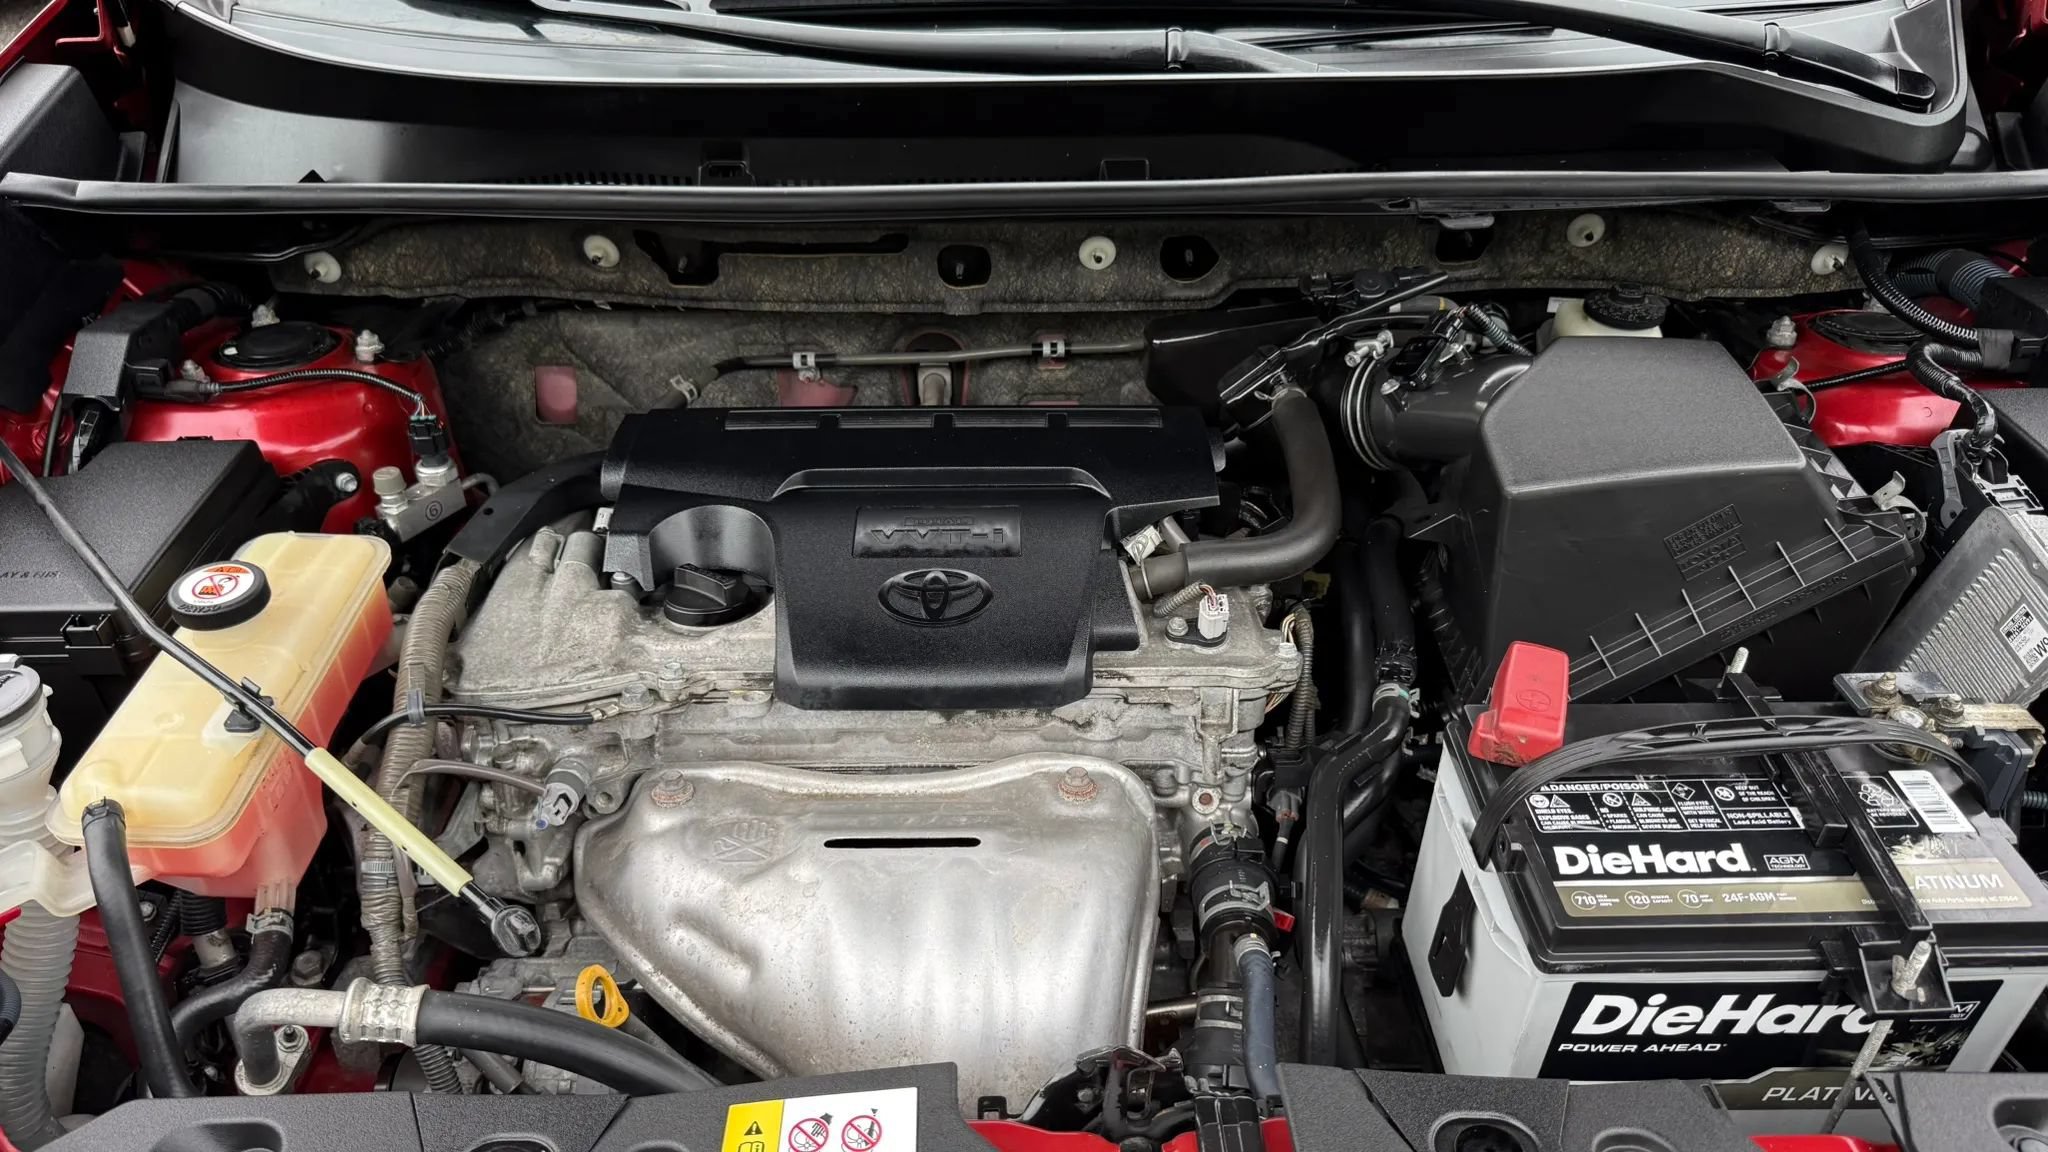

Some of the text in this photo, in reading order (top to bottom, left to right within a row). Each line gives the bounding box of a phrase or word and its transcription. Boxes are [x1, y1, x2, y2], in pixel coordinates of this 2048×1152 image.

[1550, 783, 1649, 791] DANGER/POISON
[1770, 856, 1805, 864] AGM
[1575, 896, 1597, 905] 710
[1628, 895, 1651, 904] 120
[1682, 894, 1698, 904] 70
[1722, 892, 1775, 902] 24F-AGM
[1558, 1044, 1638, 1052] POWER
